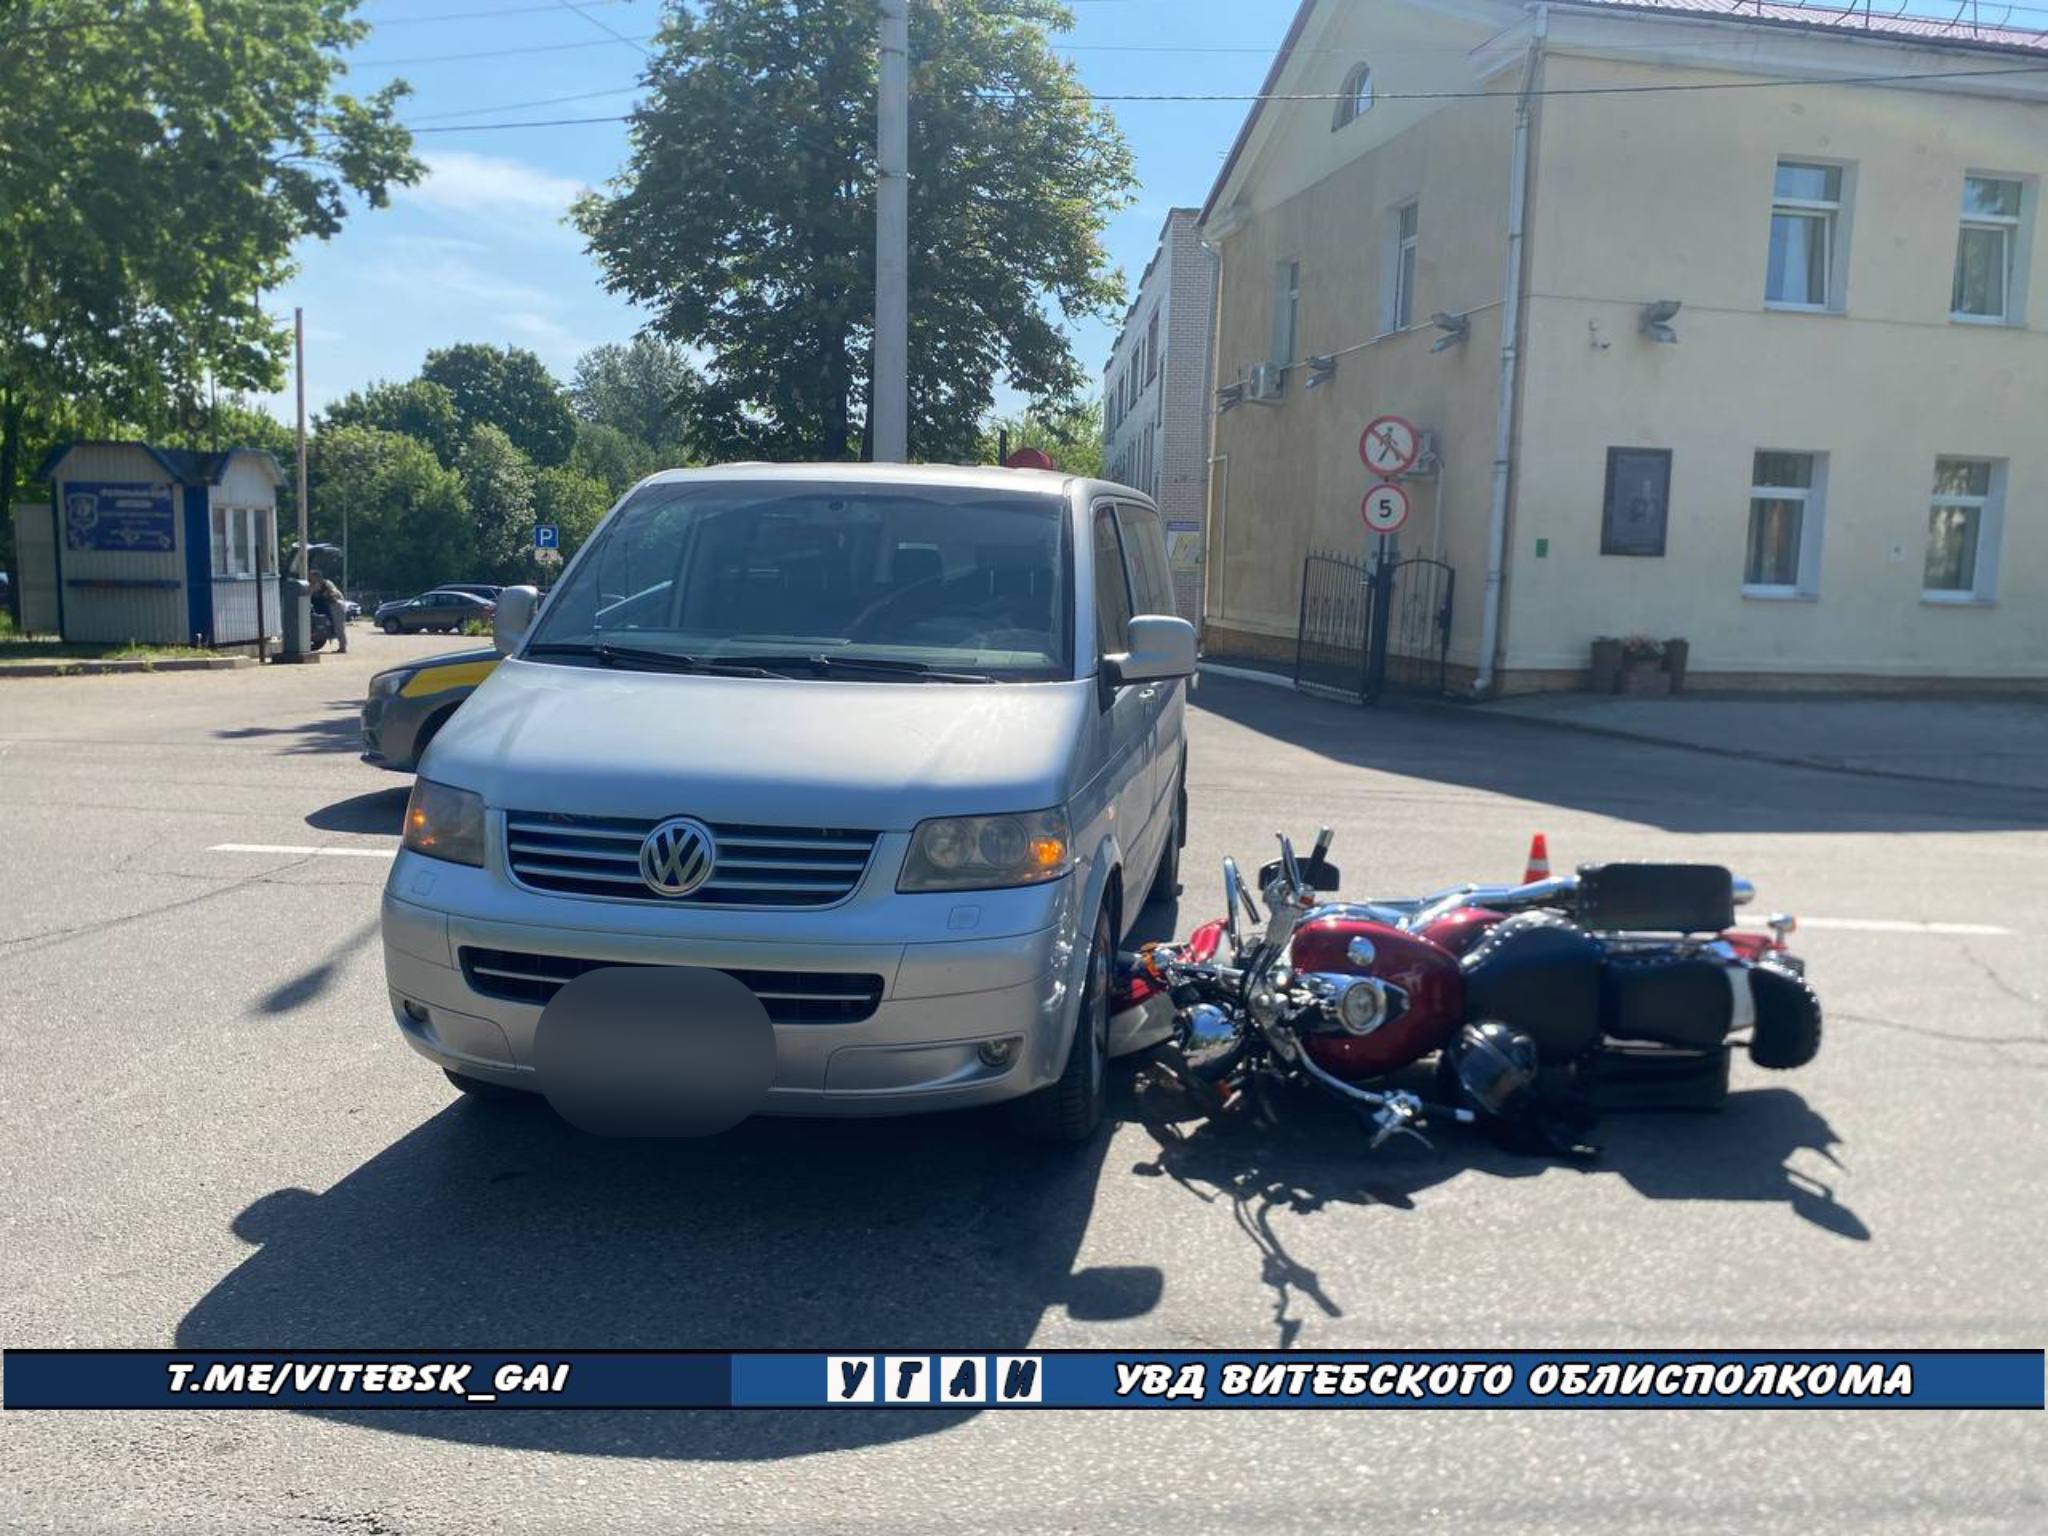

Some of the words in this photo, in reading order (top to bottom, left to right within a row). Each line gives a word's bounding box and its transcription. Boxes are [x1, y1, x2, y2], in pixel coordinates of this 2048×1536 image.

[1379, 500, 1392, 518] 5
[540, 528, 553, 546] P
[645, 822, 710, 893] VW
